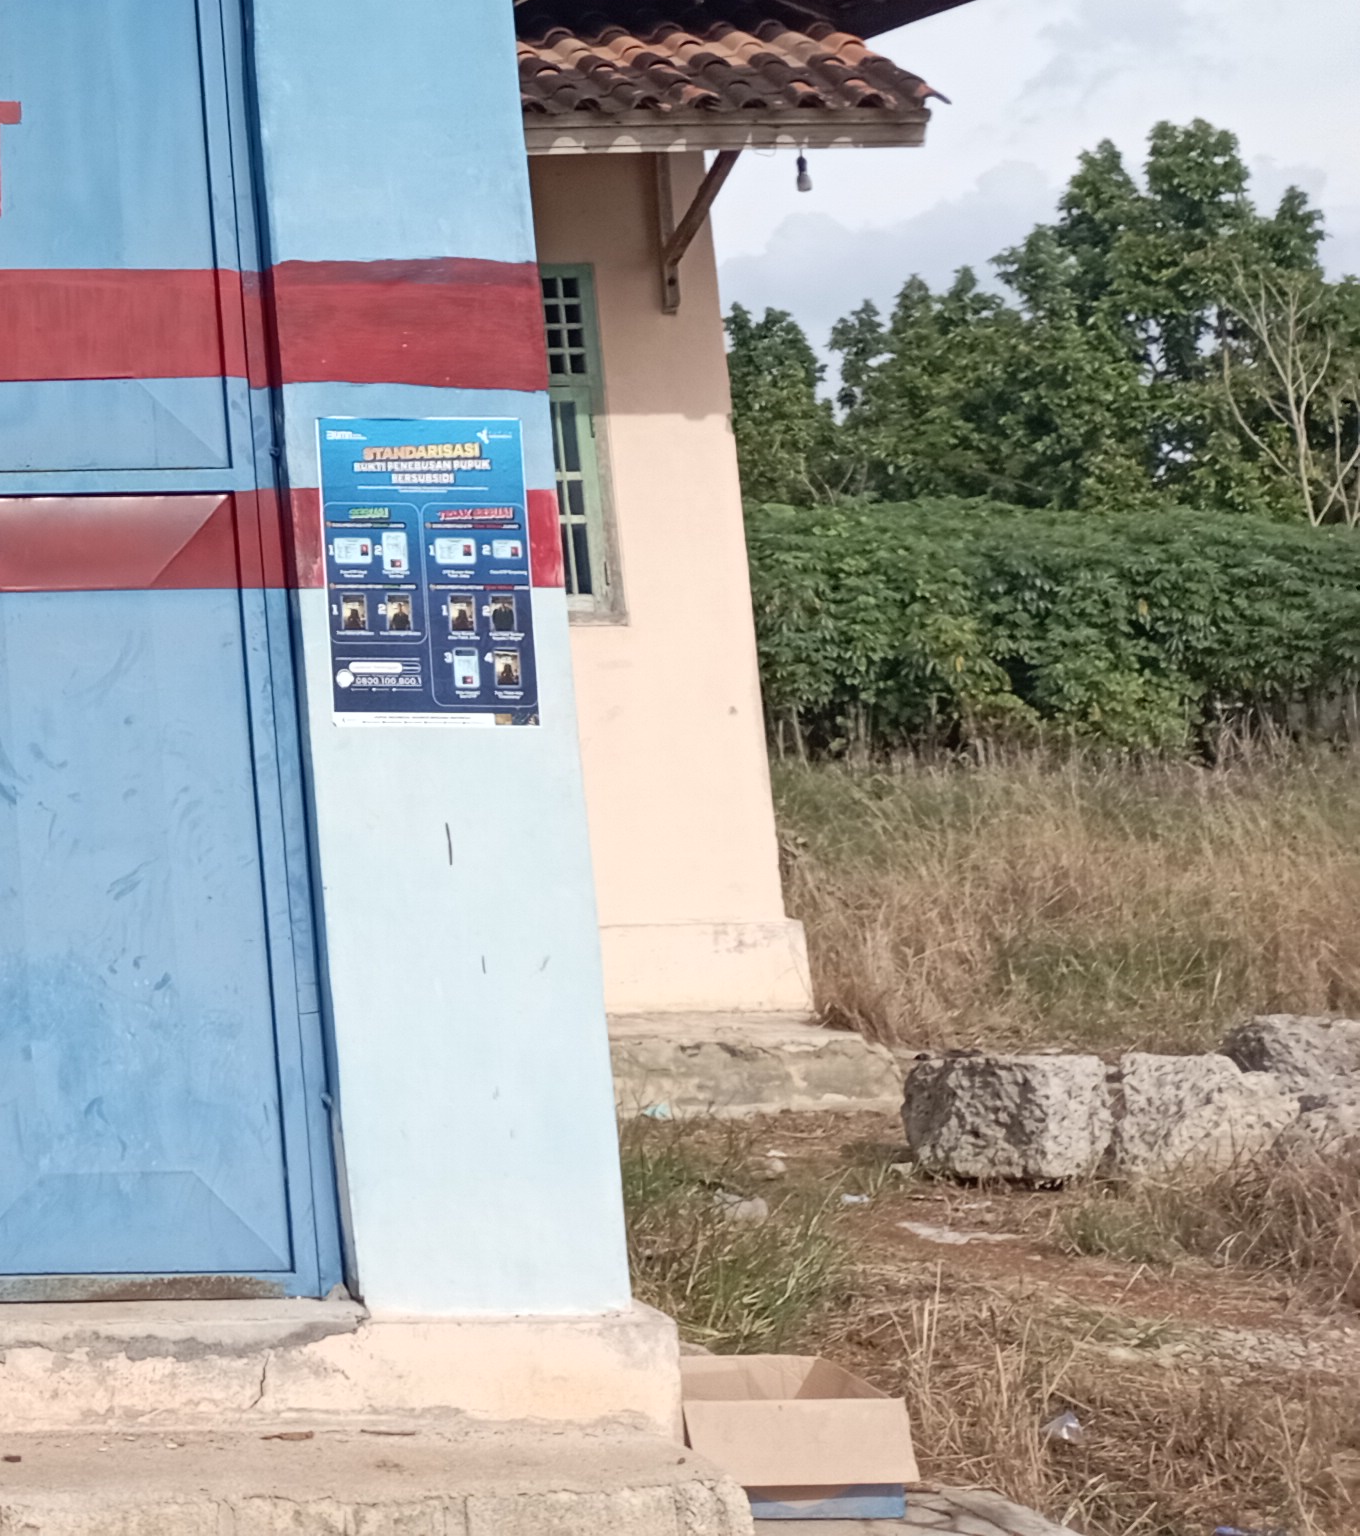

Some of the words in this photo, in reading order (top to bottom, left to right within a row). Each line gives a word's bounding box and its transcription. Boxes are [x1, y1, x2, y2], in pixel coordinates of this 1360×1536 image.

[363, 442, 480, 460] STANDARISASI
[353, 461, 387, 472] BUKTI
[387, 460, 452, 471] PENEBUSAN
[453, 459, 491, 470] PUPUK
[391, 473, 455, 484] BERSUBSIDI
[374, 545, 382, 556] 2
[482, 544, 491, 555] 2
[331, 604, 339, 615] 1
[378, 604, 387, 615] 2
[441, 604, 449, 616] 1
[482, 605, 491, 616] 2
[444, 652, 453, 663] 3
[484, 652, 493, 663] 4
